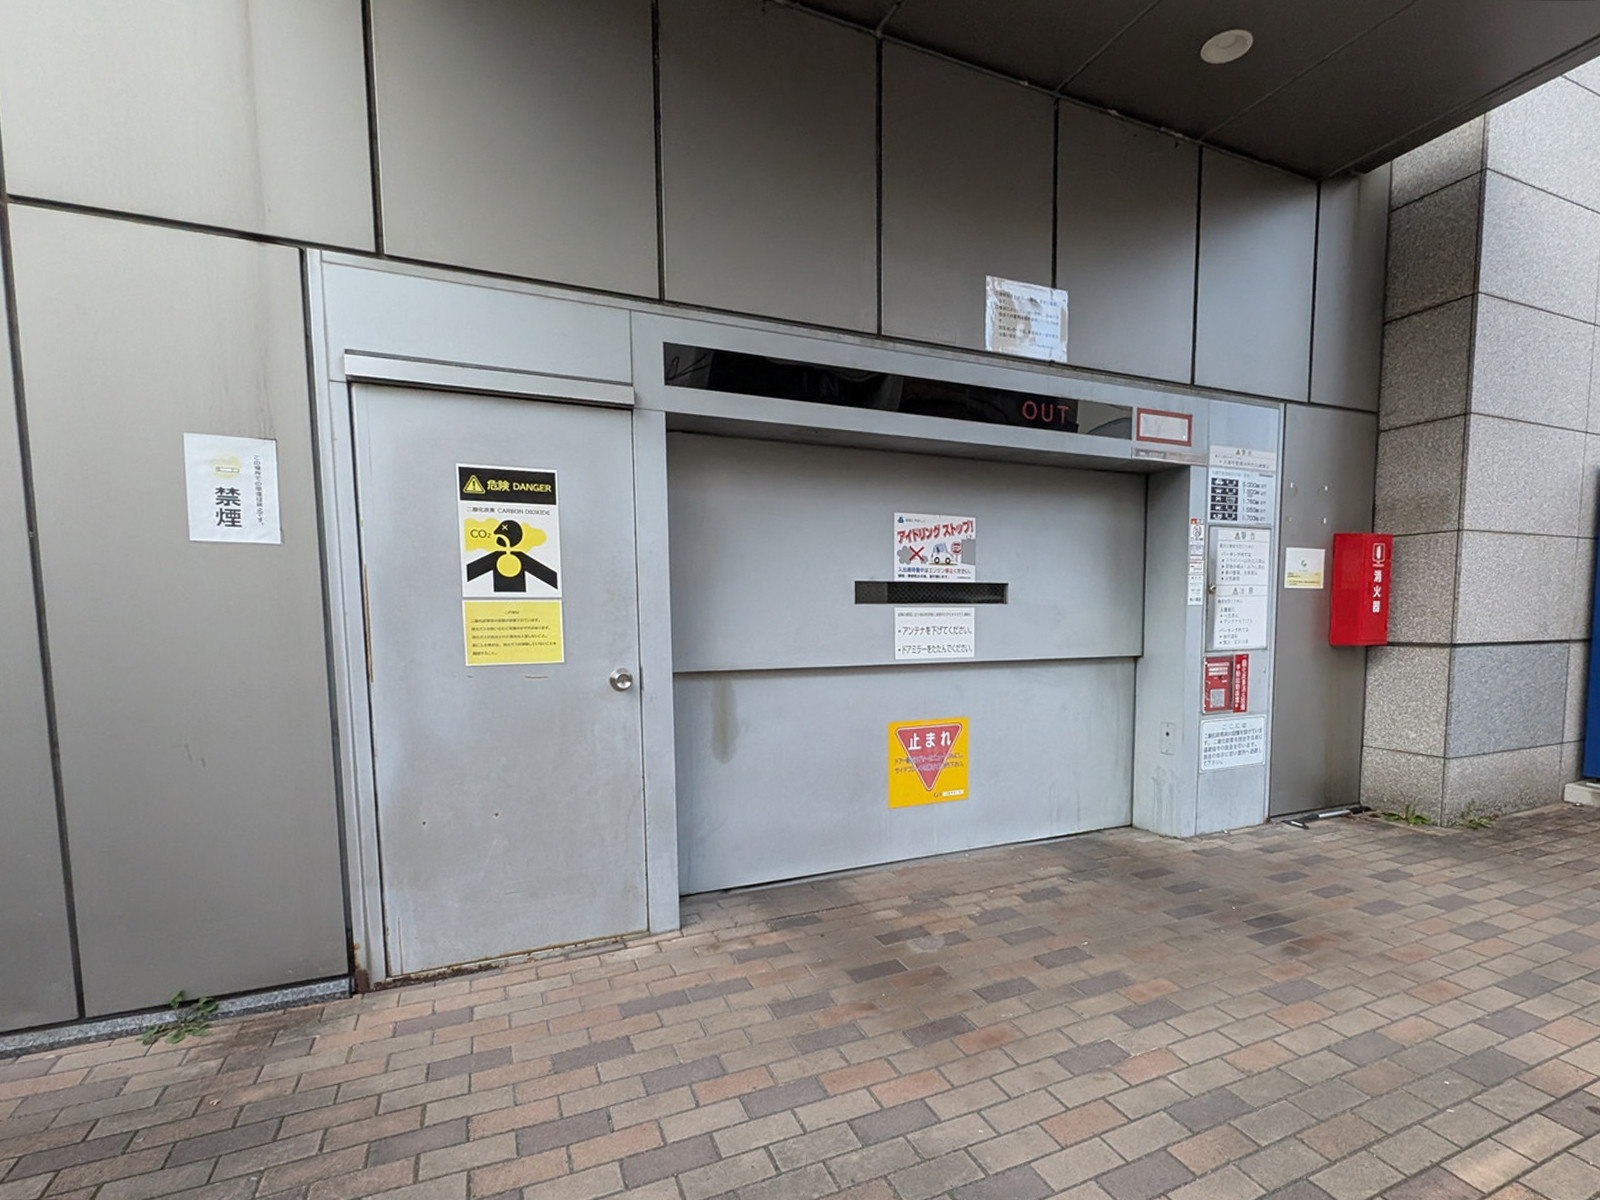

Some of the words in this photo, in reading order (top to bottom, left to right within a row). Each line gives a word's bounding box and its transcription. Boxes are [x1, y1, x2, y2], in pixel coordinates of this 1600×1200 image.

[1022, 401, 1069, 424] OUT
[487, 479, 511, 492] 危険
[513, 482, 552, 493] DANGER
[215, 486, 242, 528] 禁煙
[897, 524, 941, 544] アイドリング
[1372, 569, 1382, 613] 消火器
[908, 731, 952, 751] 止まれ
